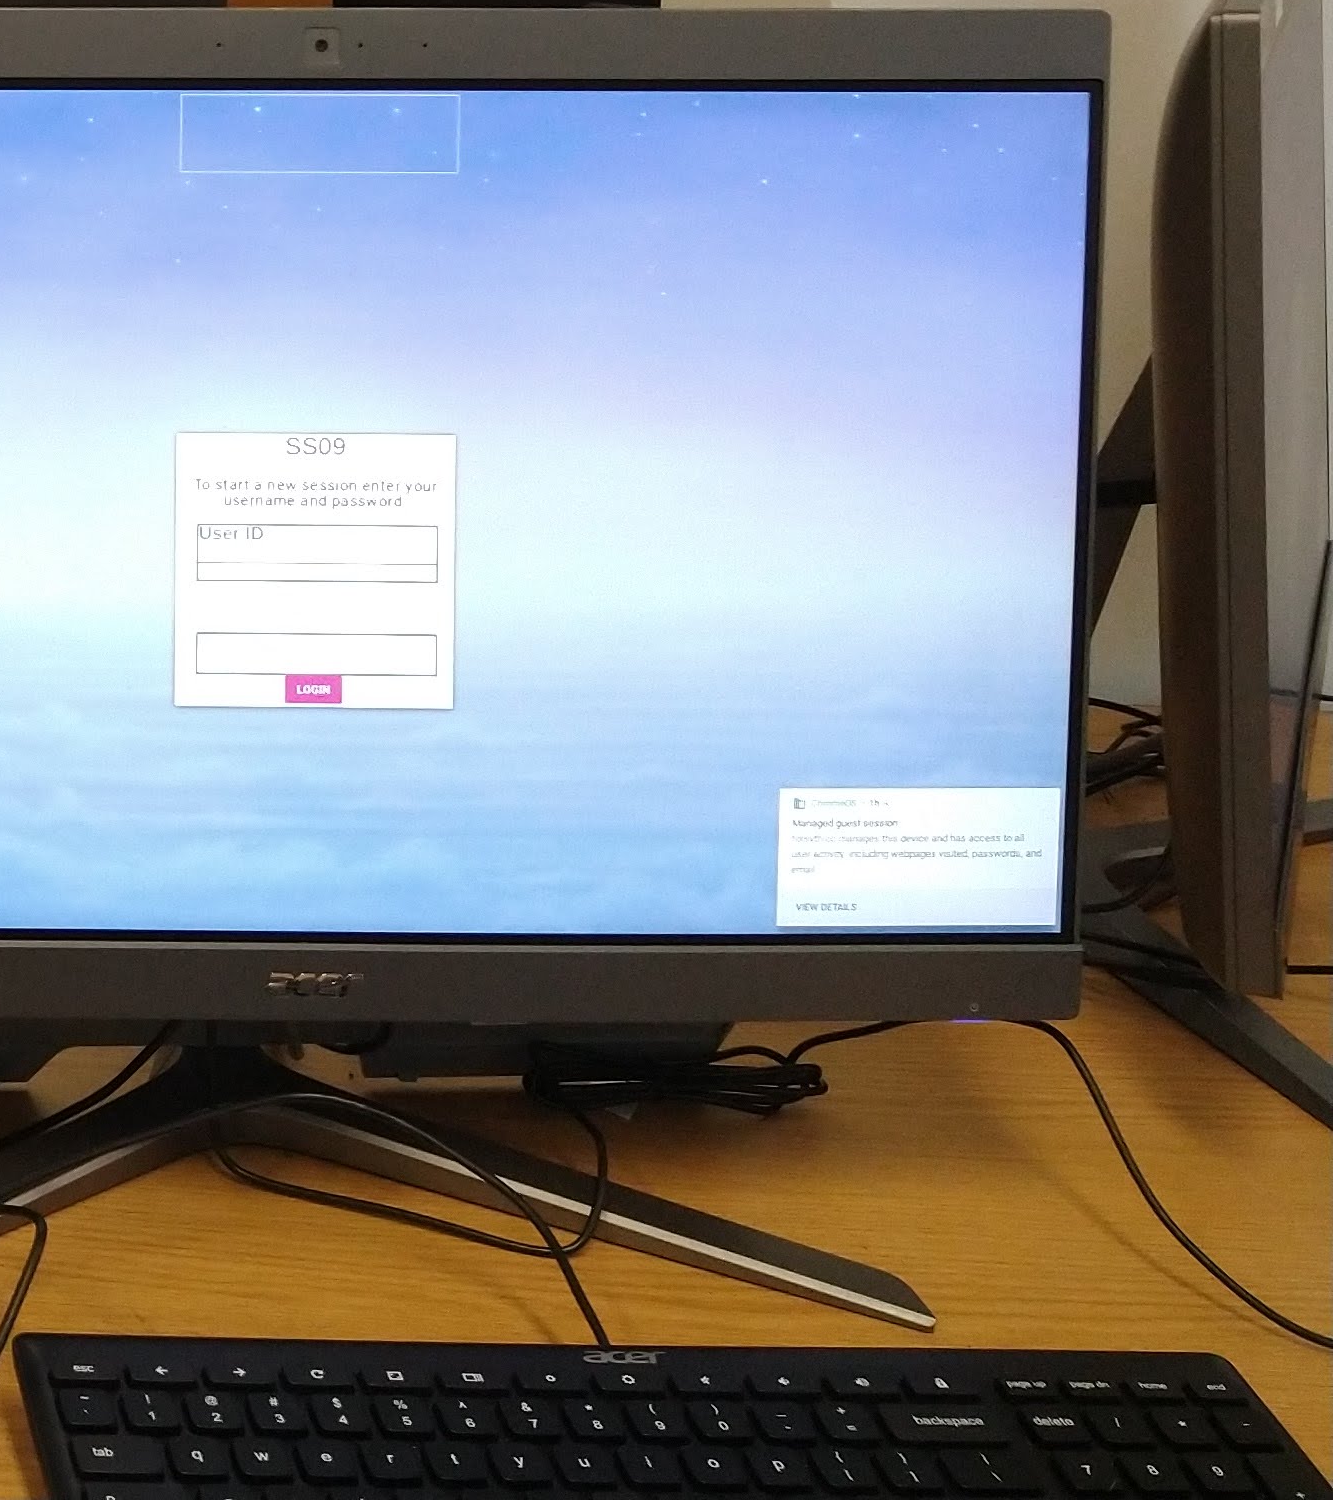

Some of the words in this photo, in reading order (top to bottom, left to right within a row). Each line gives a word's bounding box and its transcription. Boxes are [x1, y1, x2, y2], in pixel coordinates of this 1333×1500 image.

[286, 437, 346, 455] SS09
[195, 478, 211, 491] To
[215, 478, 250, 491] start
[254, 481, 262, 491] a
[267, 481, 296, 491] new
[302, 479, 358, 493] session
[361, 480, 402, 493] enter
[405, 481, 438, 495] your
[224, 495, 295, 507] username
[300, 495, 327, 507] and
[331, 495, 403, 509] password
[199, 526, 238, 540] User
[245, 526, 264, 540] ID
[295, 684, 332, 695] LOGIN
[792, 818, 834, 829] Managed
[835, 819, 861, 829] guest
[900, 834, 929, 843] device
[931, 833, 949, 843] and
[950, 833, 966, 842] has
[968, 834, 1001, 843] access
[1003, 834, 1013, 842] to
[890, 849, 936, 860] webpages
[1025, 849, 1043, 858] and
[796, 903, 818, 912] VIEW
[820, 902, 857, 912] DETAILS
[582, 1350, 665, 1364] acer
[72, 1364, 95, 1373] esc
[1137, 1381, 1168, 1390] home
[1206, 1383, 1227, 1391] end
[148, 1410, 157, 1421] 1
[211, 1412, 224, 1424] 2
[274, 1413, 286, 1424] 3
[338, 1414, 350, 1426] 4
[401, 1415, 413, 1426] 5
[911, 1414, 985, 1428] backspace
[1032, 1415, 1075, 1427] delete
[464, 1417, 476, 1428] 6
[527, 1418, 538, 1429] 7
[591, 1419, 604, 1430] 8
[654, 1420, 666, 1431] 9
[717, 1420, 730, 1431] 0
[91, 1446, 114, 1457] tab
[190, 1450, 205, 1463] q
[253, 1451, 269, 1462] w
[320, 1452, 334, 1463] e
[385, 1454, 395, 1464] r
[450, 1453, 460, 1465] t
[512, 1456, 524, 1469] y
[577, 1458, 591, 1468] u
[707, 1458, 721, 1469] o
[771, 1460, 786, 1473] p
[1080, 1464, 1092, 1476] 7
[1146, 1464, 1160, 1476] 8
[1211, 1465, 1224, 1477] 9
